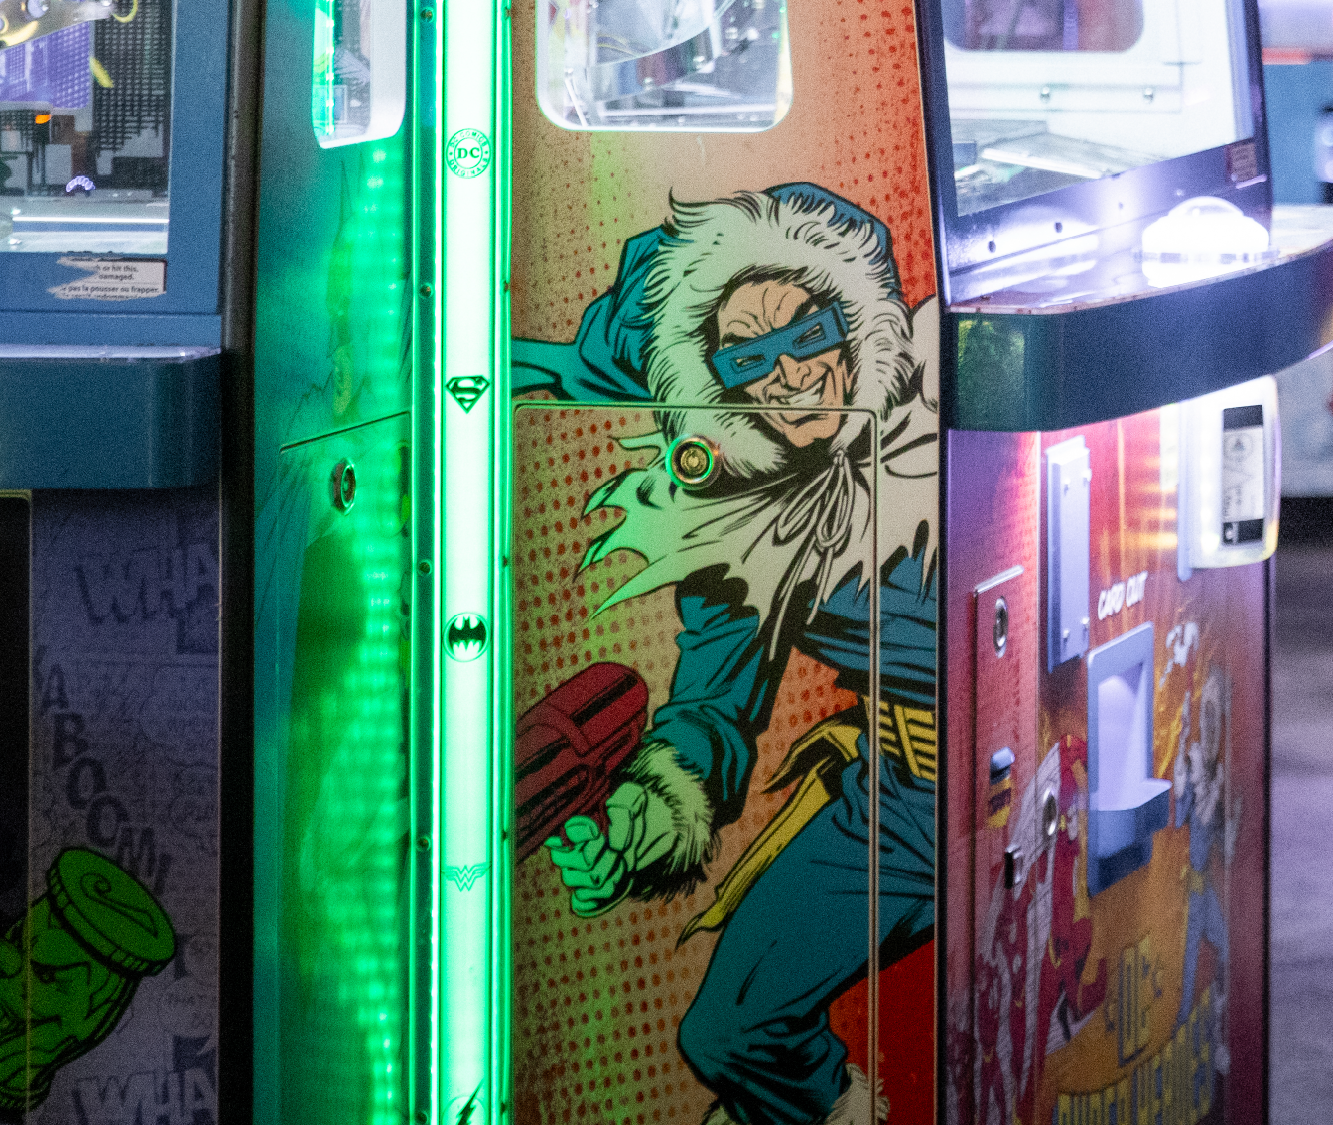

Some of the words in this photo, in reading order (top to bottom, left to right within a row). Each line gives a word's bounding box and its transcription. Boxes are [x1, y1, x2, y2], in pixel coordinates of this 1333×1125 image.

[457, 147, 480, 159] DC
[1097, 581, 1126, 621] CARD
[1126, 570, 1149, 608] OUT
